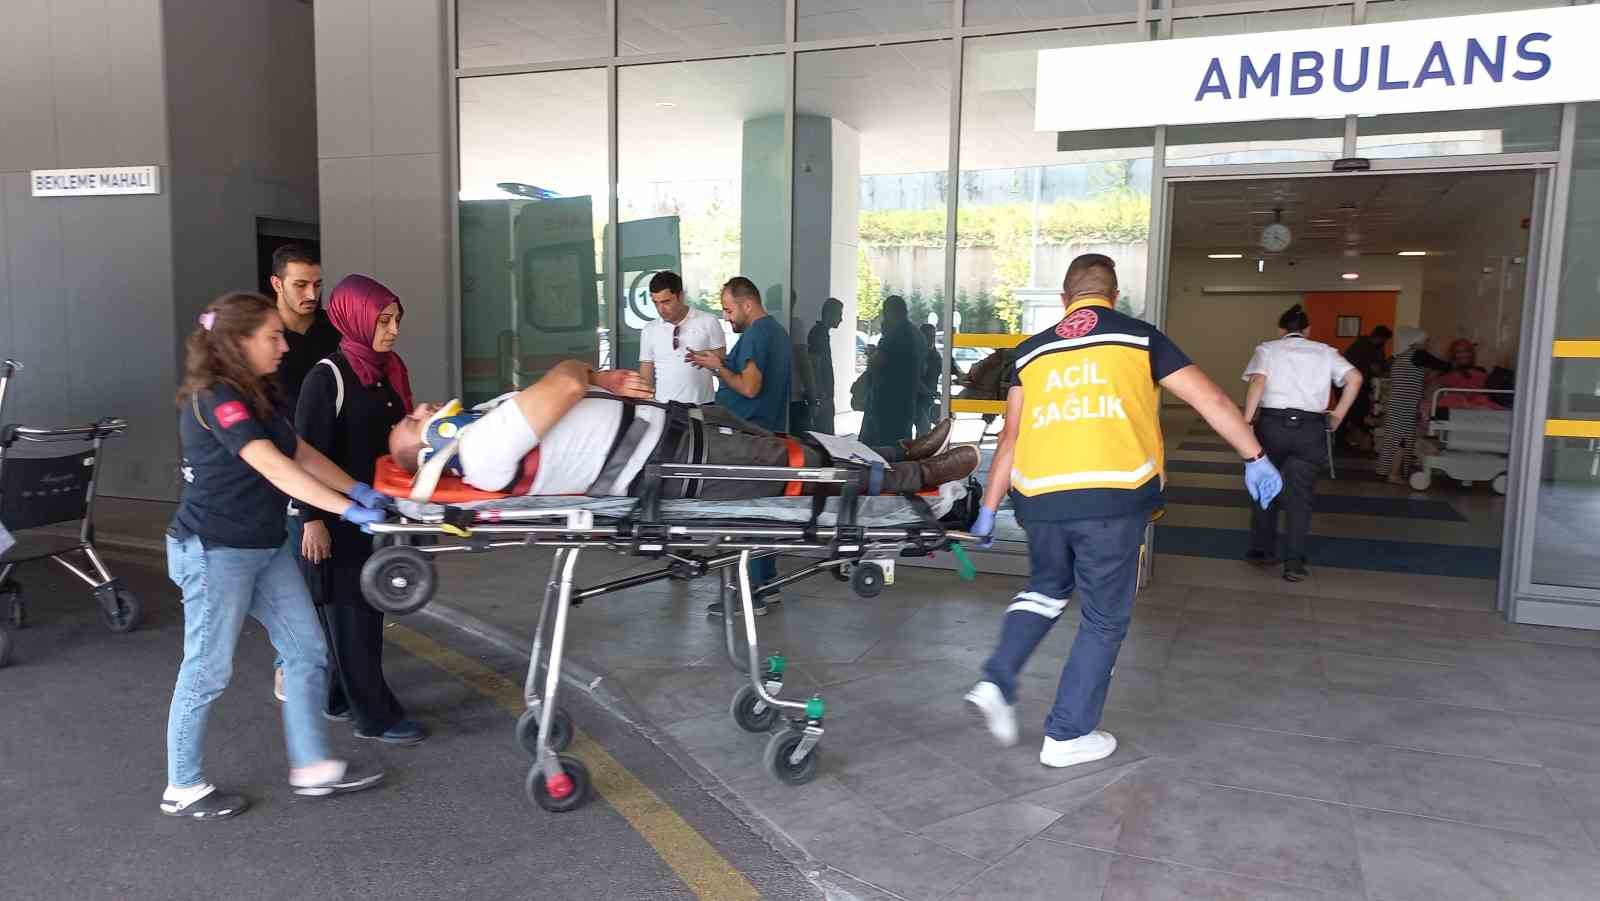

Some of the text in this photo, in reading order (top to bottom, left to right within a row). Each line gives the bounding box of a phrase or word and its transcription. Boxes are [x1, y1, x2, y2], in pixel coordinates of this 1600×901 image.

[1195, 32, 1552, 101] AMBULANS
[36, 168, 152, 190] BEKLEME MAHALİ
[1045, 359, 1108, 392] ACİL
[1032, 393, 1126, 429] SAĞLIK
